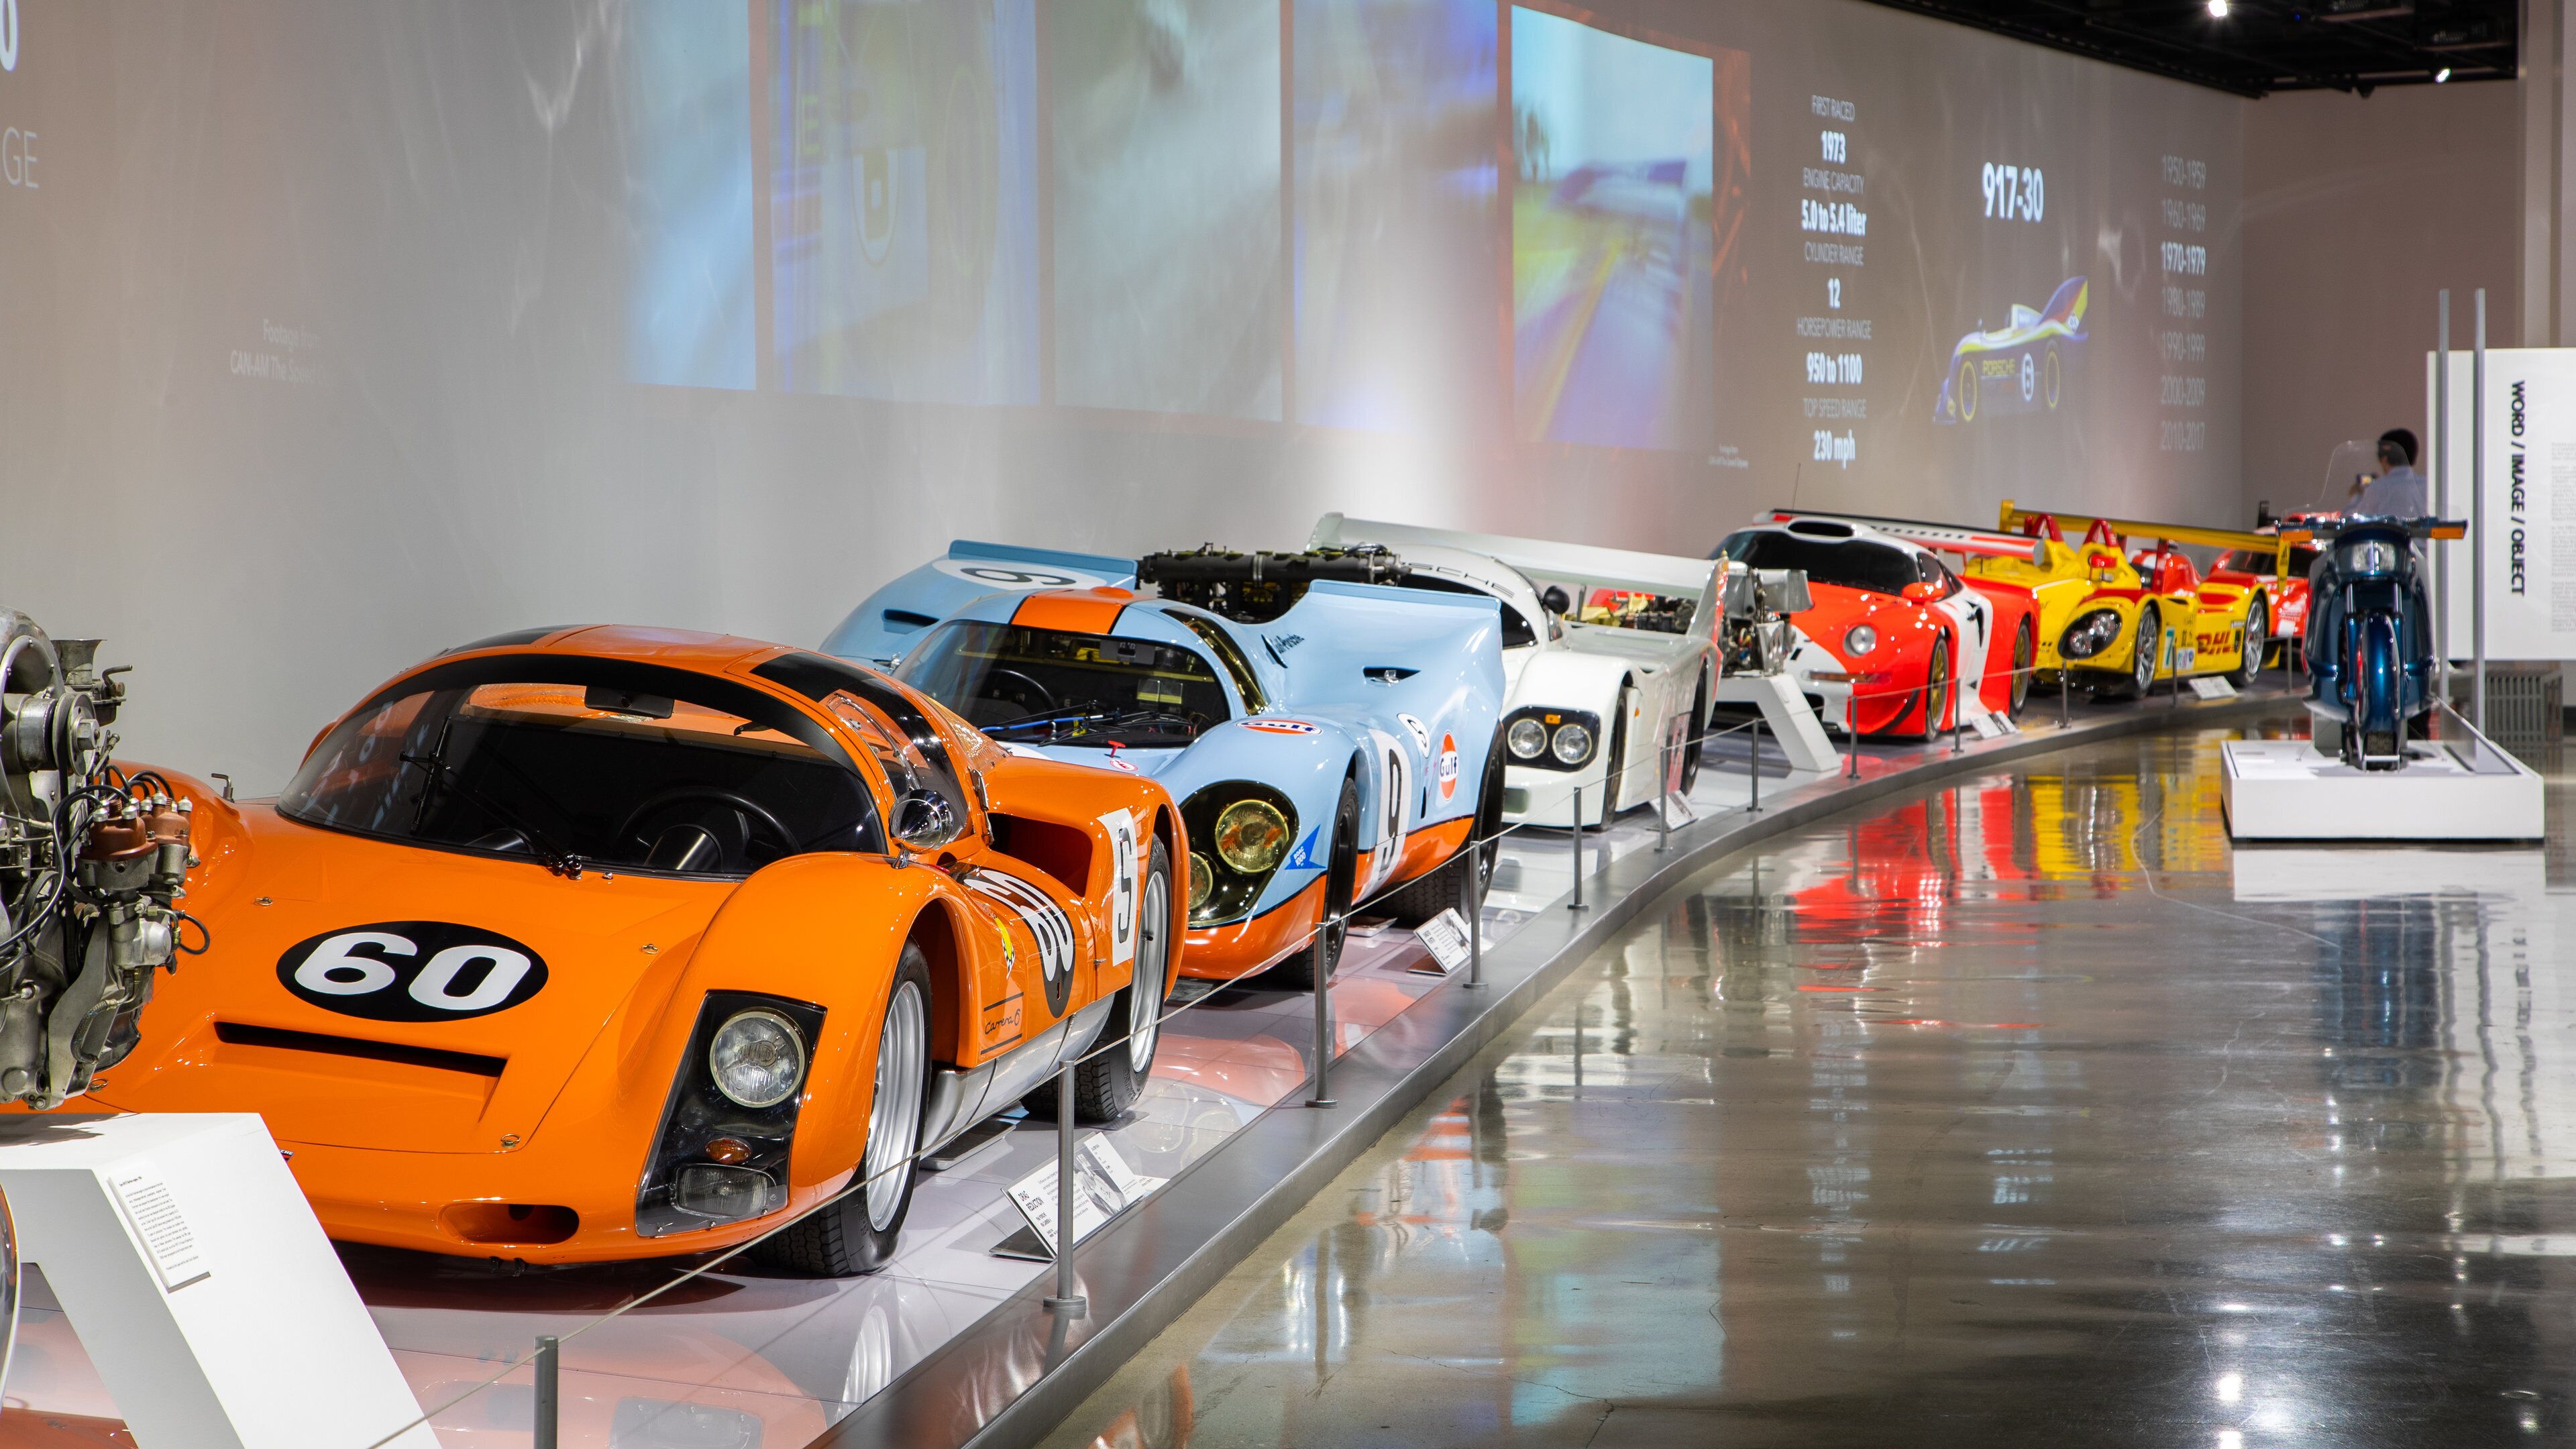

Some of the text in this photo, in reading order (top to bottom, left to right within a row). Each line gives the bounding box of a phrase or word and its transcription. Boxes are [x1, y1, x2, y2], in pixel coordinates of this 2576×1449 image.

[1812, 95, 1856, 122] FIRST RACED
[1821, 130, 1846, 164] 1973
[1803, 167, 1864, 194] ENGINE CAPACITY
[2162, 154, 2206, 189] 1950-1959
[1982, 162, 2043, 223] 917-30
[1801, 199, 1867, 236] 5.0 to 5.4 liter
[2162, 199, 2206, 231] 1960-1969
[1805, 241, 1864, 266] CYLINDER RANGE
[2161, 241, 2206, 276] 1970-1979
[1827, 278, 1841, 309] 12
[2162, 286, 2205, 319] 1980-1989
[263, 319, 299, 353] Footage
[1797, 317, 1872, 339] HORSEPOWER RANGE
[2162, 331, 2205, 362] 1990-1999
[230, 350, 269, 378] CAN-AM
[271, 355, 286, 381] The
[1807, 352, 1862, 384] 950 to 1100
[2161, 375, 2205, 407] 2000-2009
[1803, 397, 1867, 419] TOP SPEED RANGE
[2511, 380, 2525, 436] WORD
[1814, 429, 1856, 470] 230 mph
[2161, 421, 2205, 451] 2010-2017
[2511, 453, 2525, 512] IMAGE
[2511, 528, 2525, 596] OBJECT
[1401, 562, 1515, 598] SCHE
[2166, 631, 2174, 665] 7
[2196, 631, 2231, 655] DHL
[1440, 757, 1457, 777] Gulf
[1378, 749, 1402, 880] 9
[1293, 846, 1304, 860] BOAC
[1295, 851, 1306, 867] 1000
[964, 869, 1074, 981] 60
[294, 932, 531, 1010] 60
[985, 1008, 1021, 1034] Carrera 6
